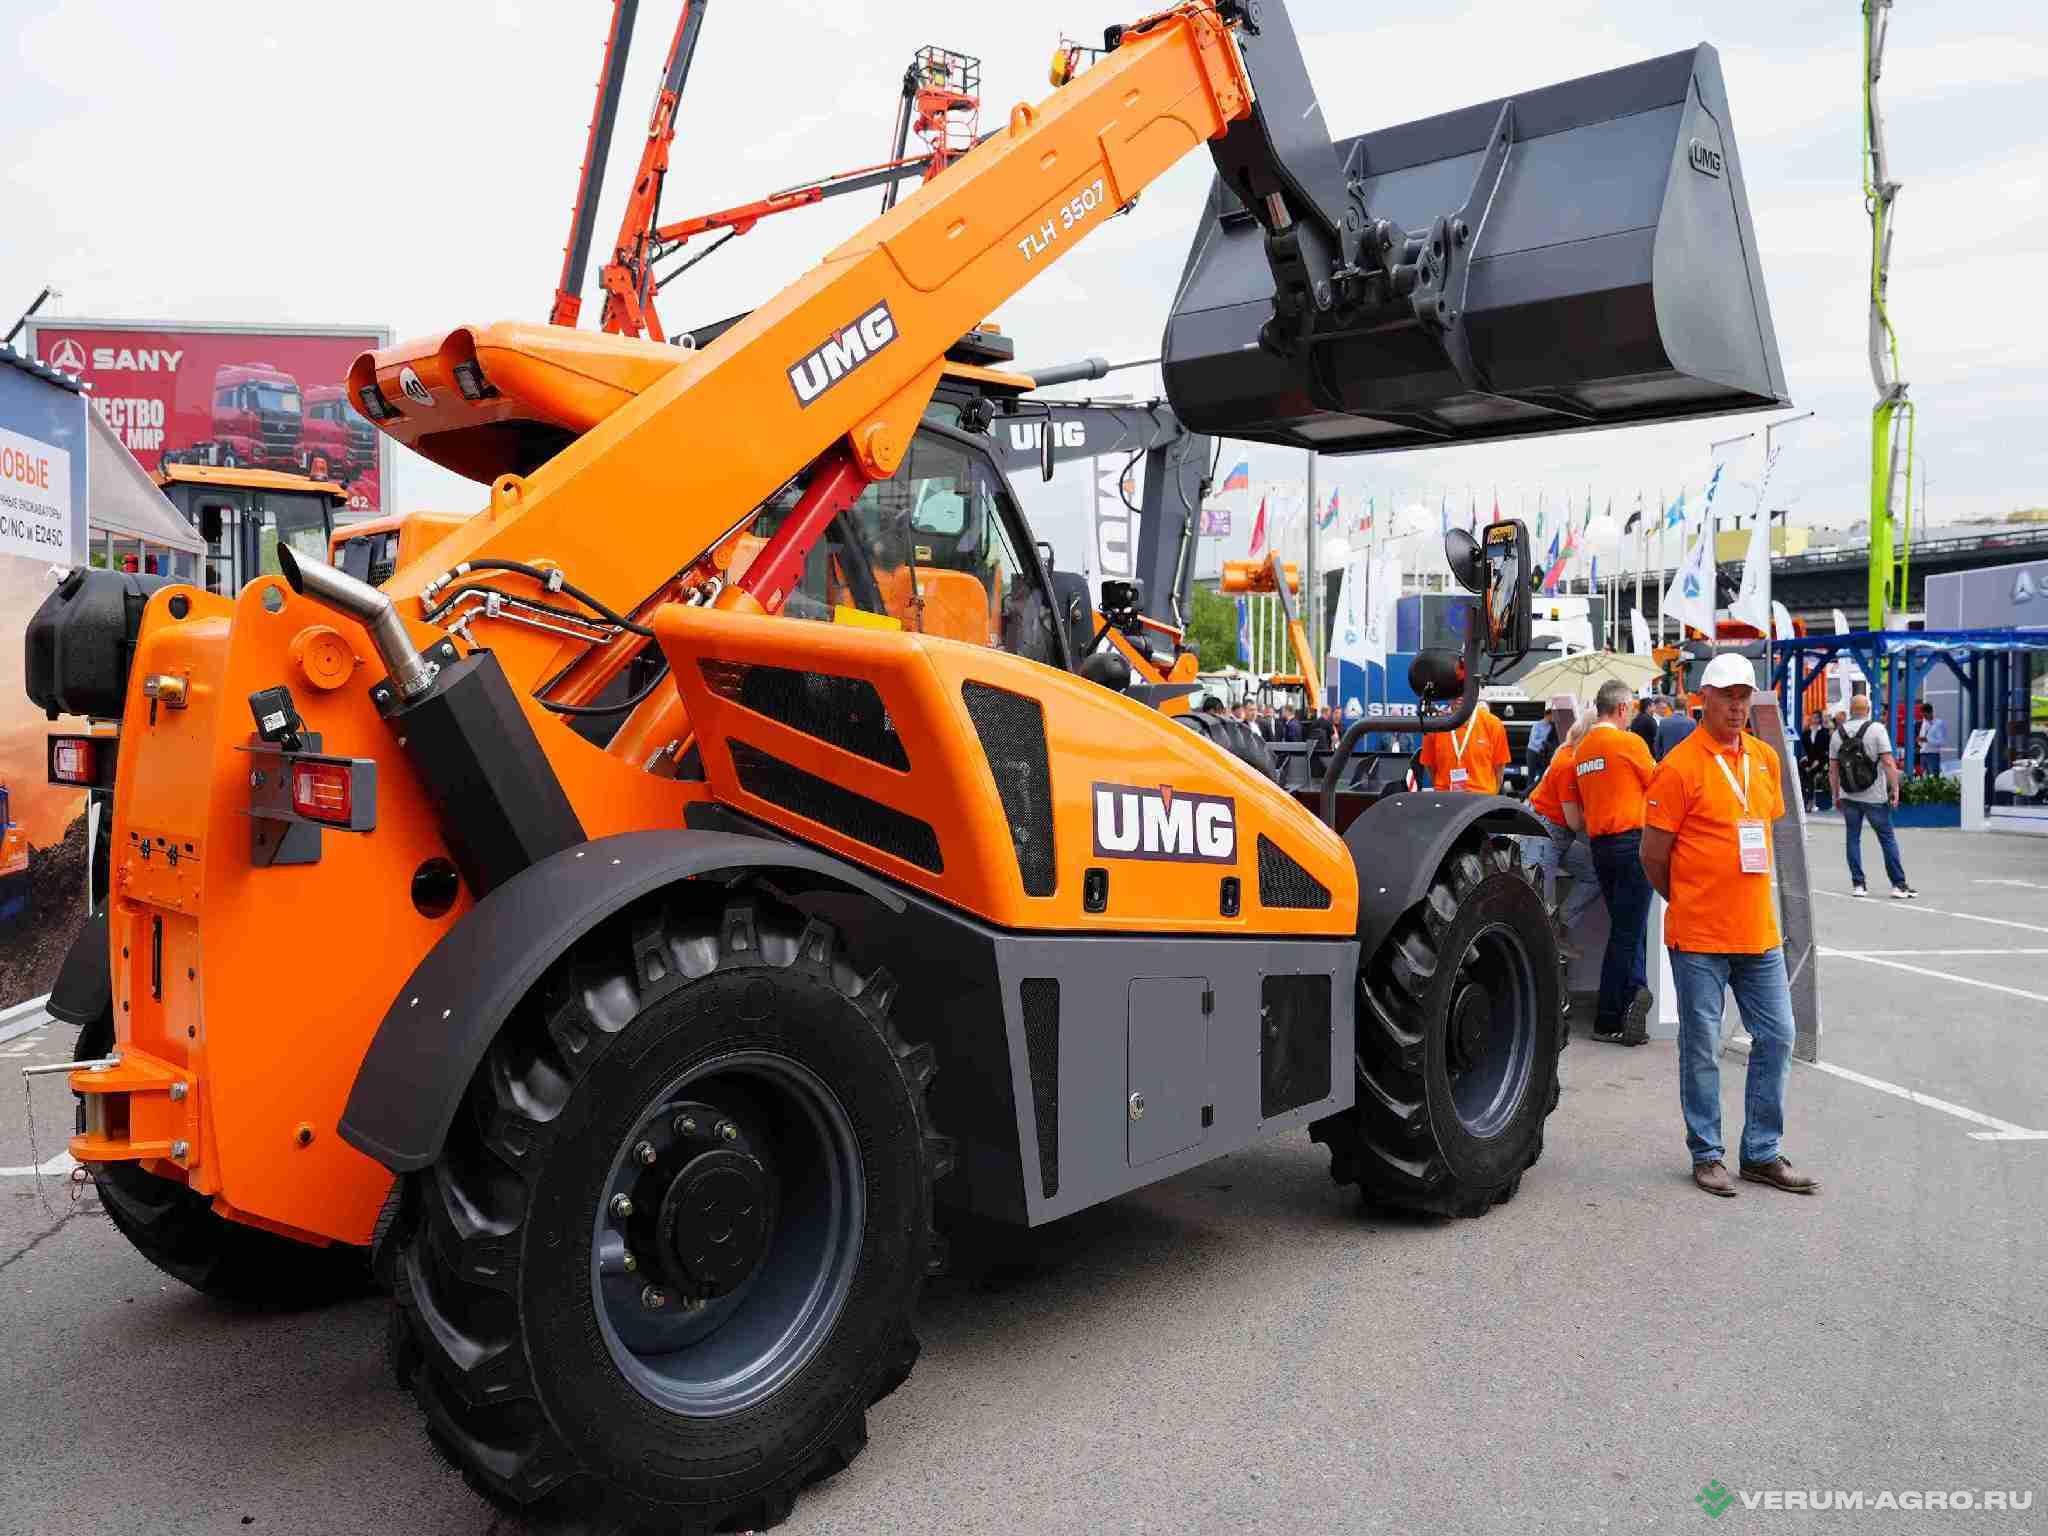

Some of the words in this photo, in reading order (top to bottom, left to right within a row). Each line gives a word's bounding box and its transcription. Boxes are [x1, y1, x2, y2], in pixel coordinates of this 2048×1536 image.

[1694, 144, 1721, 172] UMG
[1017, 219, 1056, 262] TLH
[1060, 178, 1105, 229] 3507
[92, 348, 183, 372] SANY
[789, 306, 894, 401] UMG
[93, 397, 165, 428] ЕСТВО
[0, 447, 49, 490] ОВЫЕ
[1096, 791, 1234, 857] UMG
